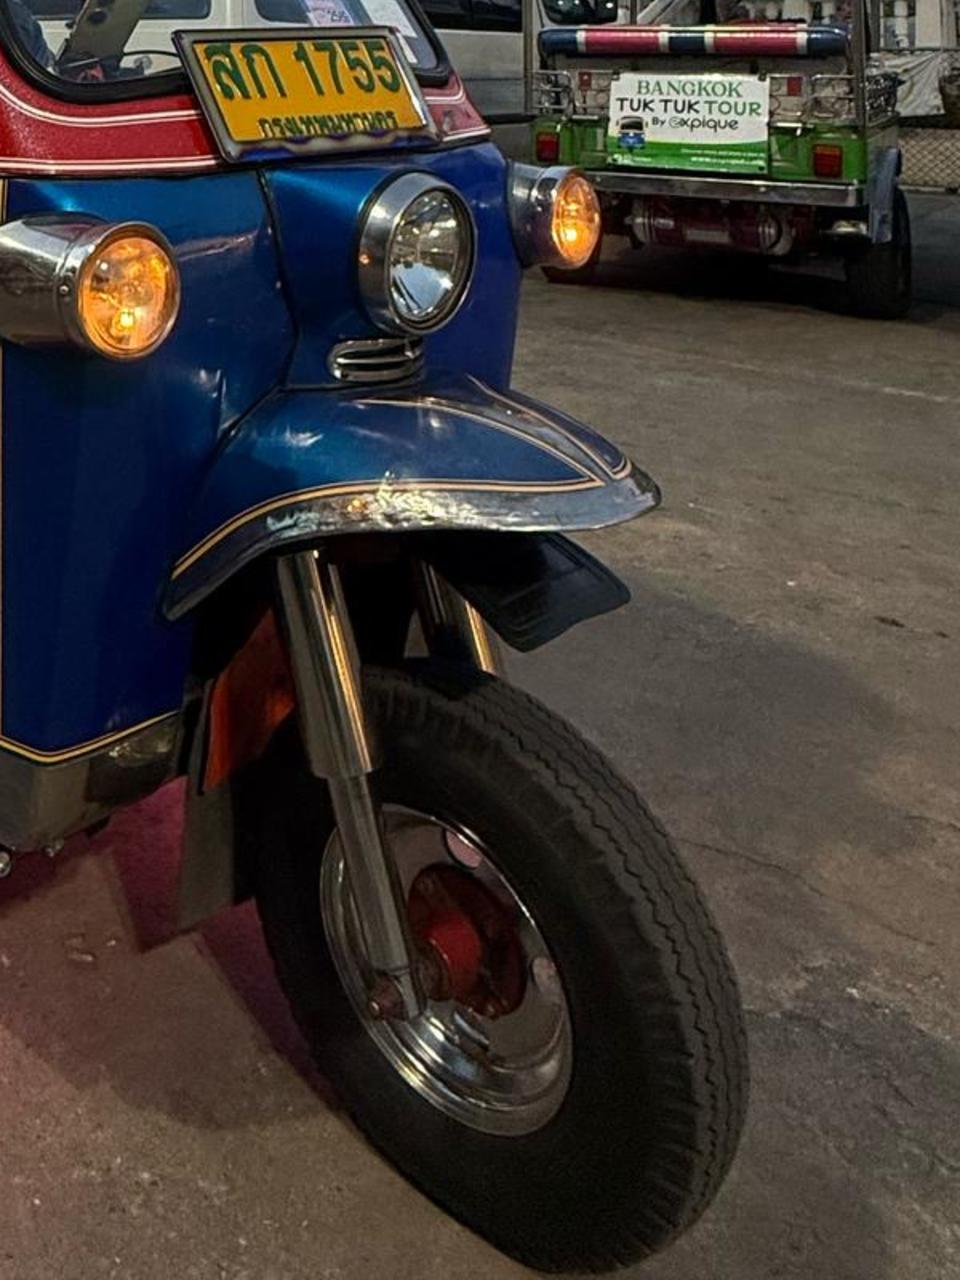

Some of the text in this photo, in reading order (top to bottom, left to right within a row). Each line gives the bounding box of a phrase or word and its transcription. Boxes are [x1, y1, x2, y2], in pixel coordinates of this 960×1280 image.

[204, 41, 402, 101] สก 1755
[637, 79, 744, 98] BANGKOK
[615, 97, 762, 117] TUK TUK TOUR
[258, 110, 399, 139] กรงเทพมหานคร
[651, 116, 666, 128] By
